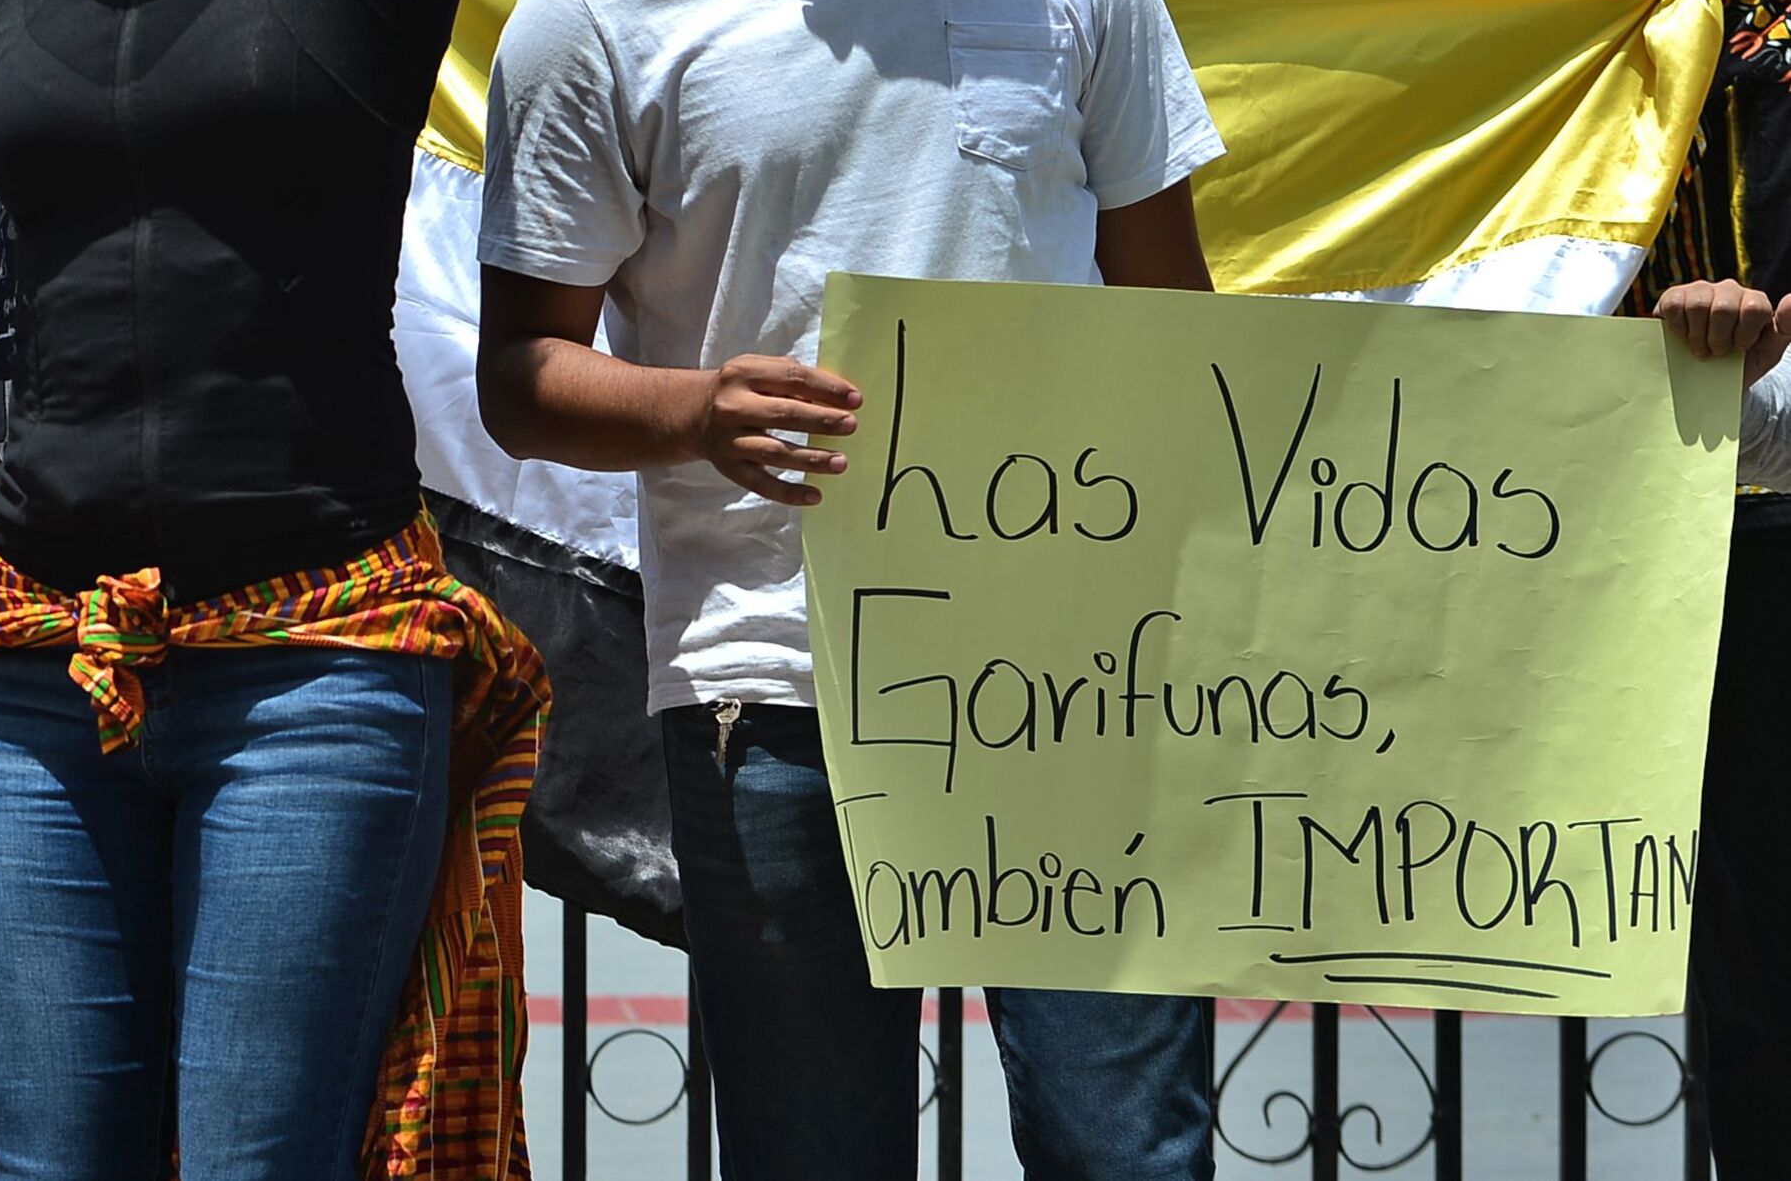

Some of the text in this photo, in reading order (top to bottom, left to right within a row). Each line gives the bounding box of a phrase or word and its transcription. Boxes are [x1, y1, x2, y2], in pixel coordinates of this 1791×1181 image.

[876, 318, 1561, 559] Las Vidas
[850, 587, 1397, 793] Garifunas,
[1203, 792, 1697, 948] IMPORTAN
